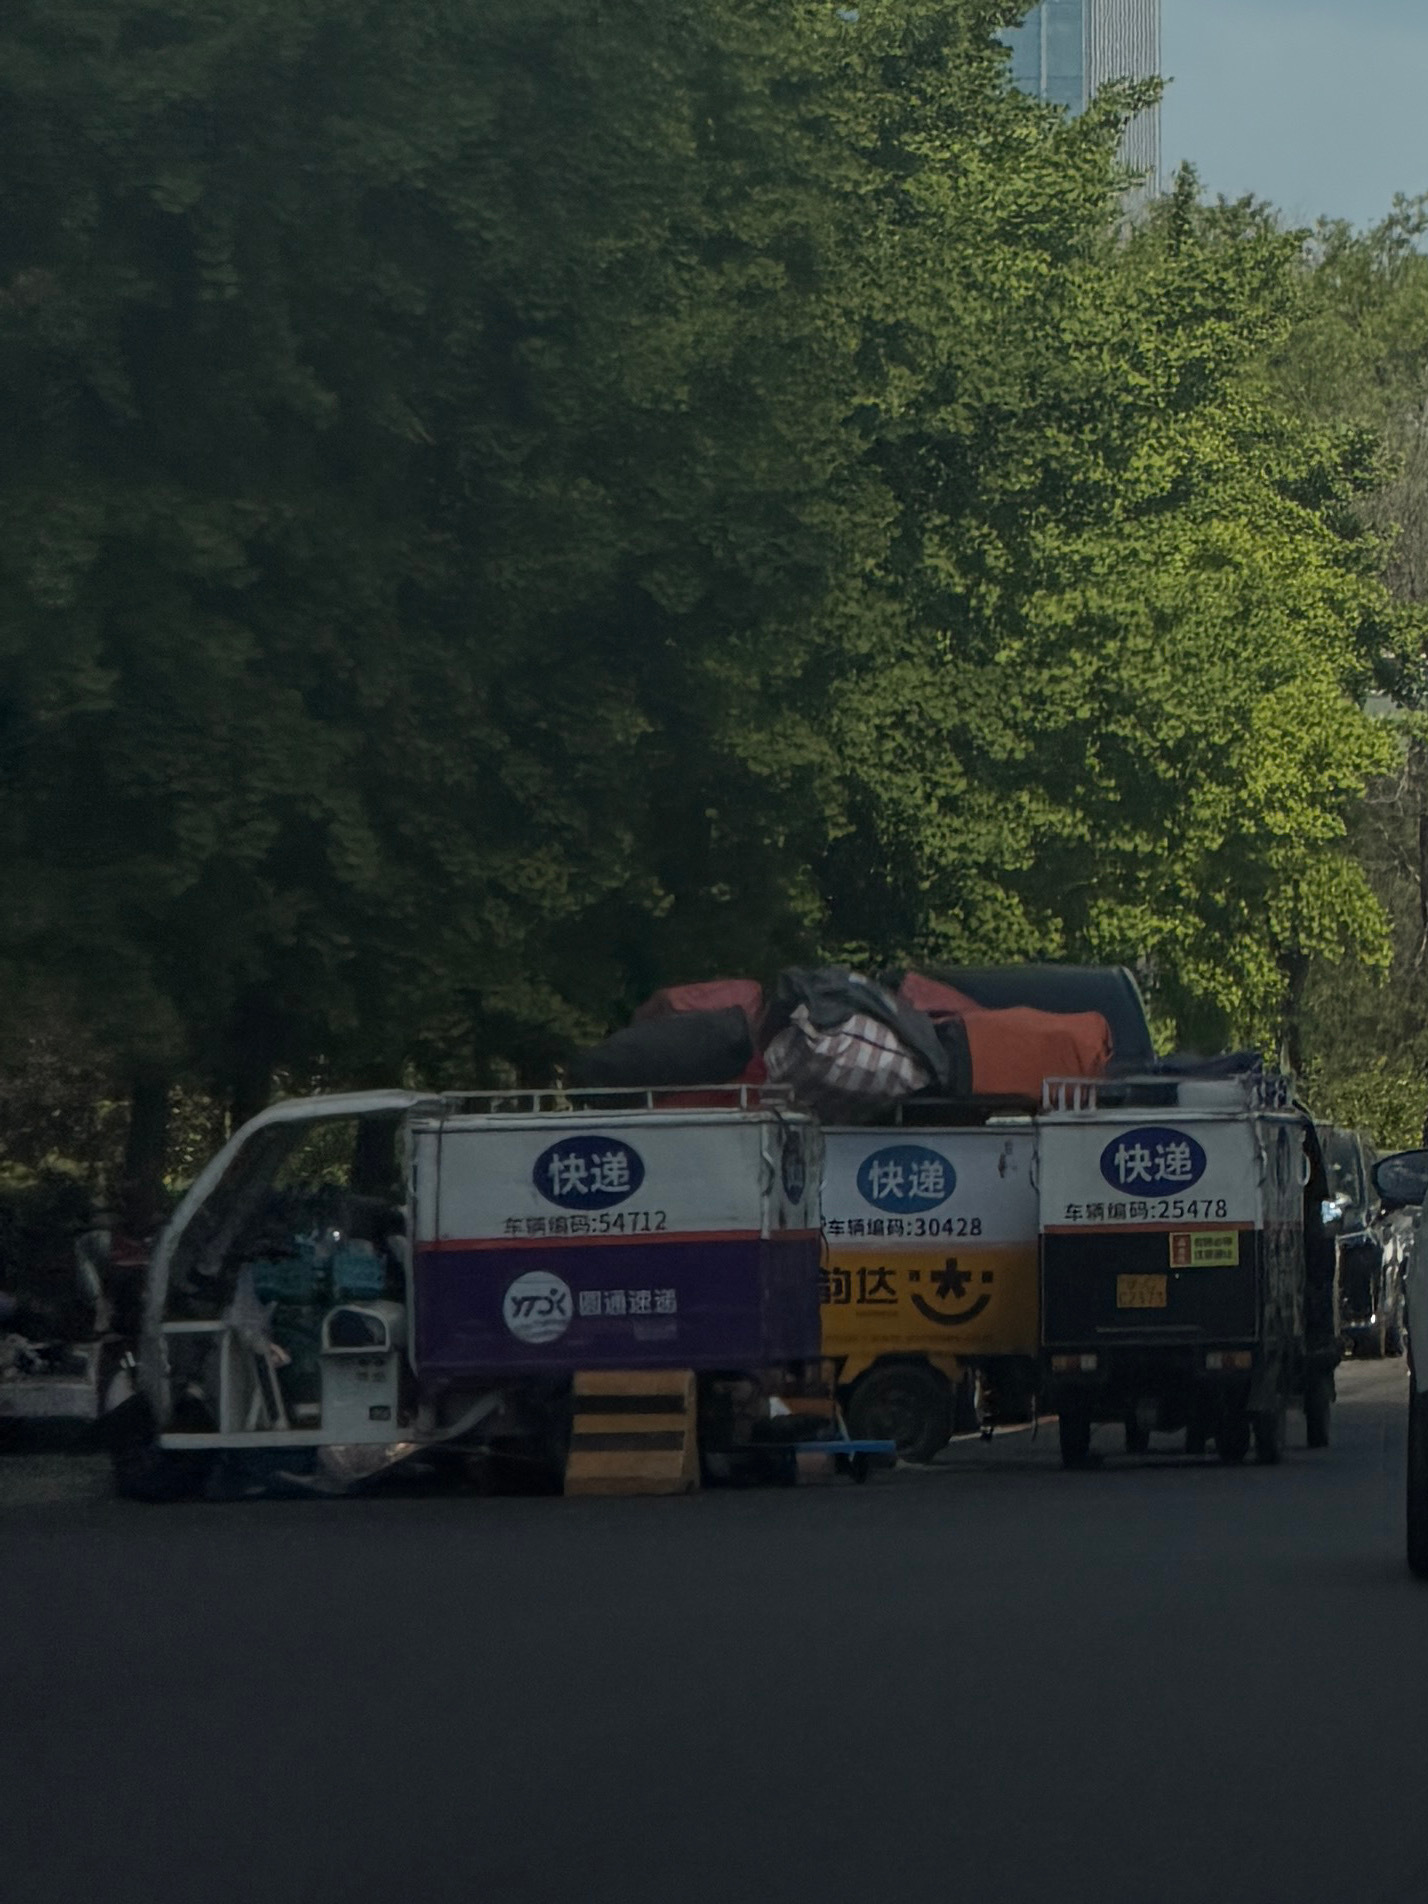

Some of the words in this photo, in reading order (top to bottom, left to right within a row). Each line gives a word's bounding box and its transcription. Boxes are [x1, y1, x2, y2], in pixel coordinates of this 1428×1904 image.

[547, 1151, 631, 1196] 快递
[868, 1158, 946, 1200] 快递
[1114, 1140, 1194, 1184] 快递
[1064, 1198, 1228, 1222] 车辆编码:25478
